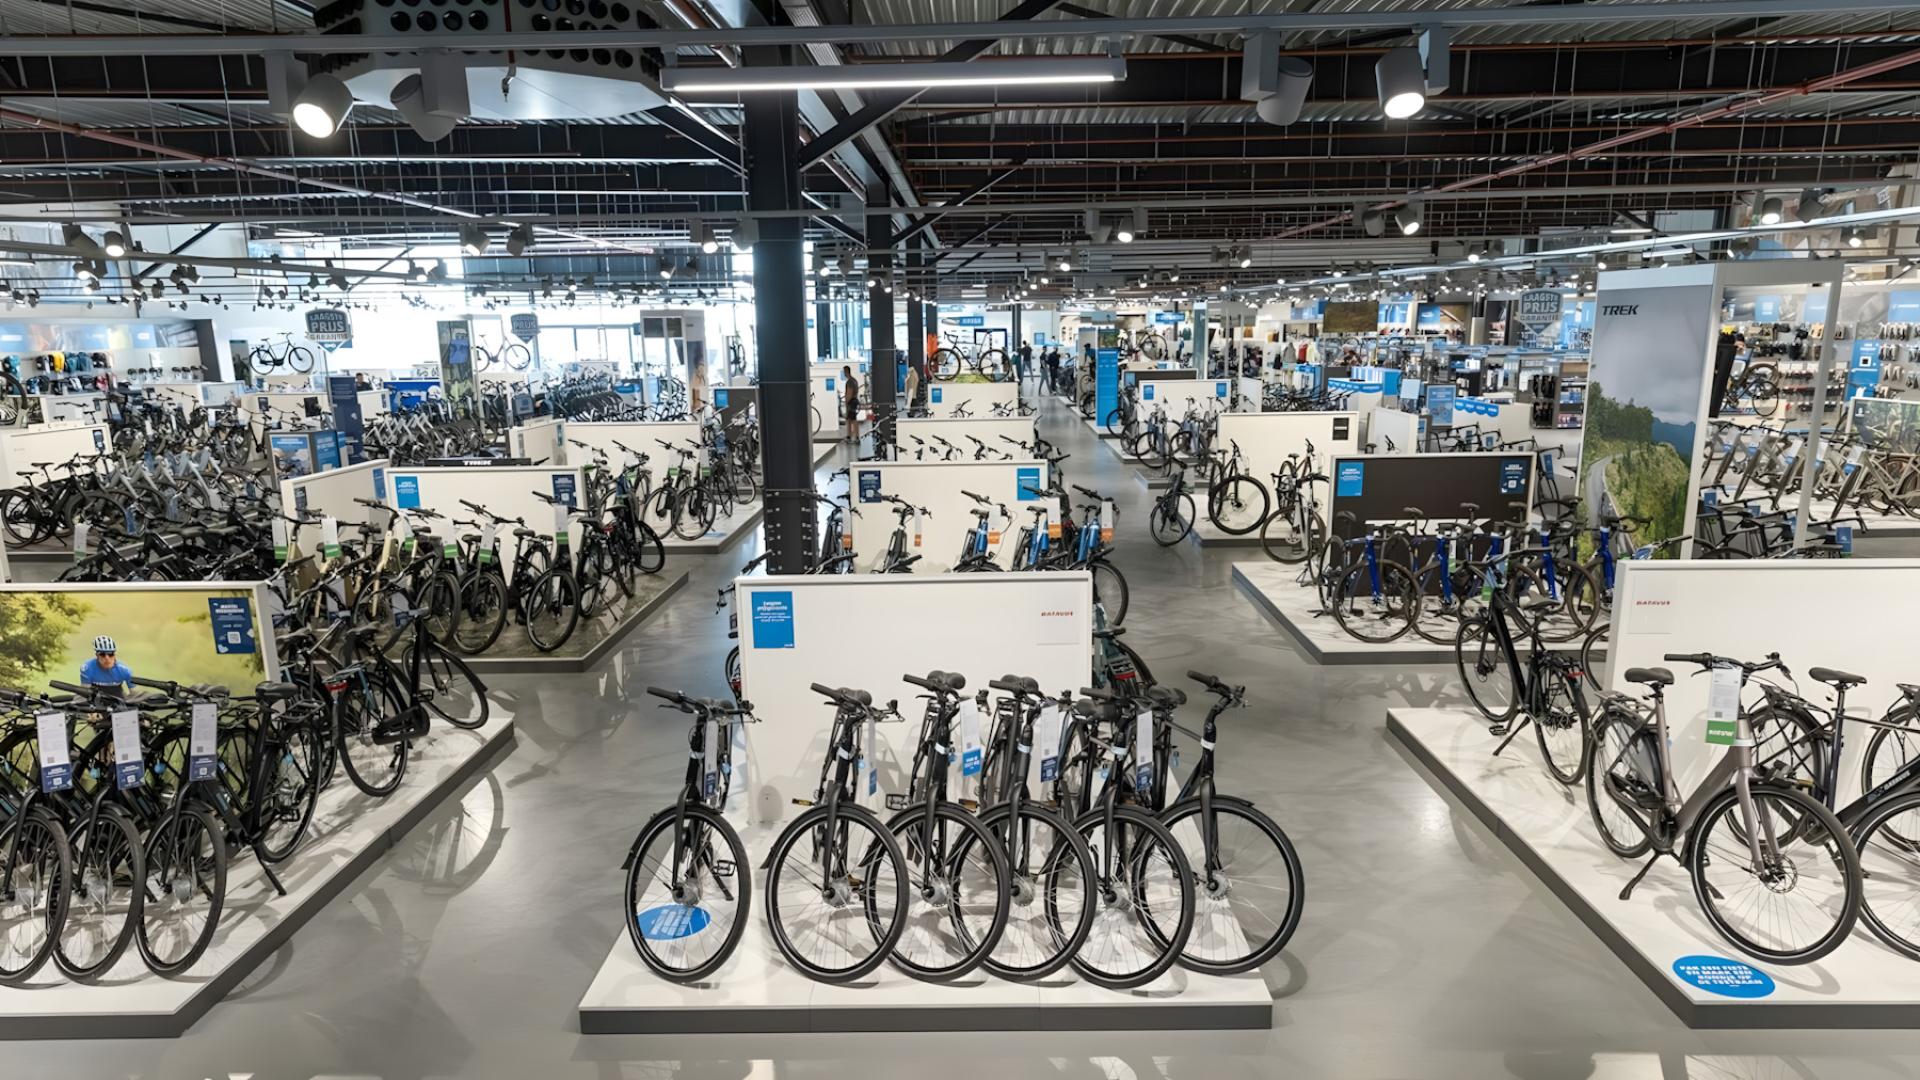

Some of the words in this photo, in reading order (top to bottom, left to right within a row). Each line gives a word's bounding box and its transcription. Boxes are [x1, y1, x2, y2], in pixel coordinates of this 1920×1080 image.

[1523, 301, 1558, 313] PRIJS
[1602, 304, 1639, 316] TREK
[311, 321, 345, 332] PRIJS
